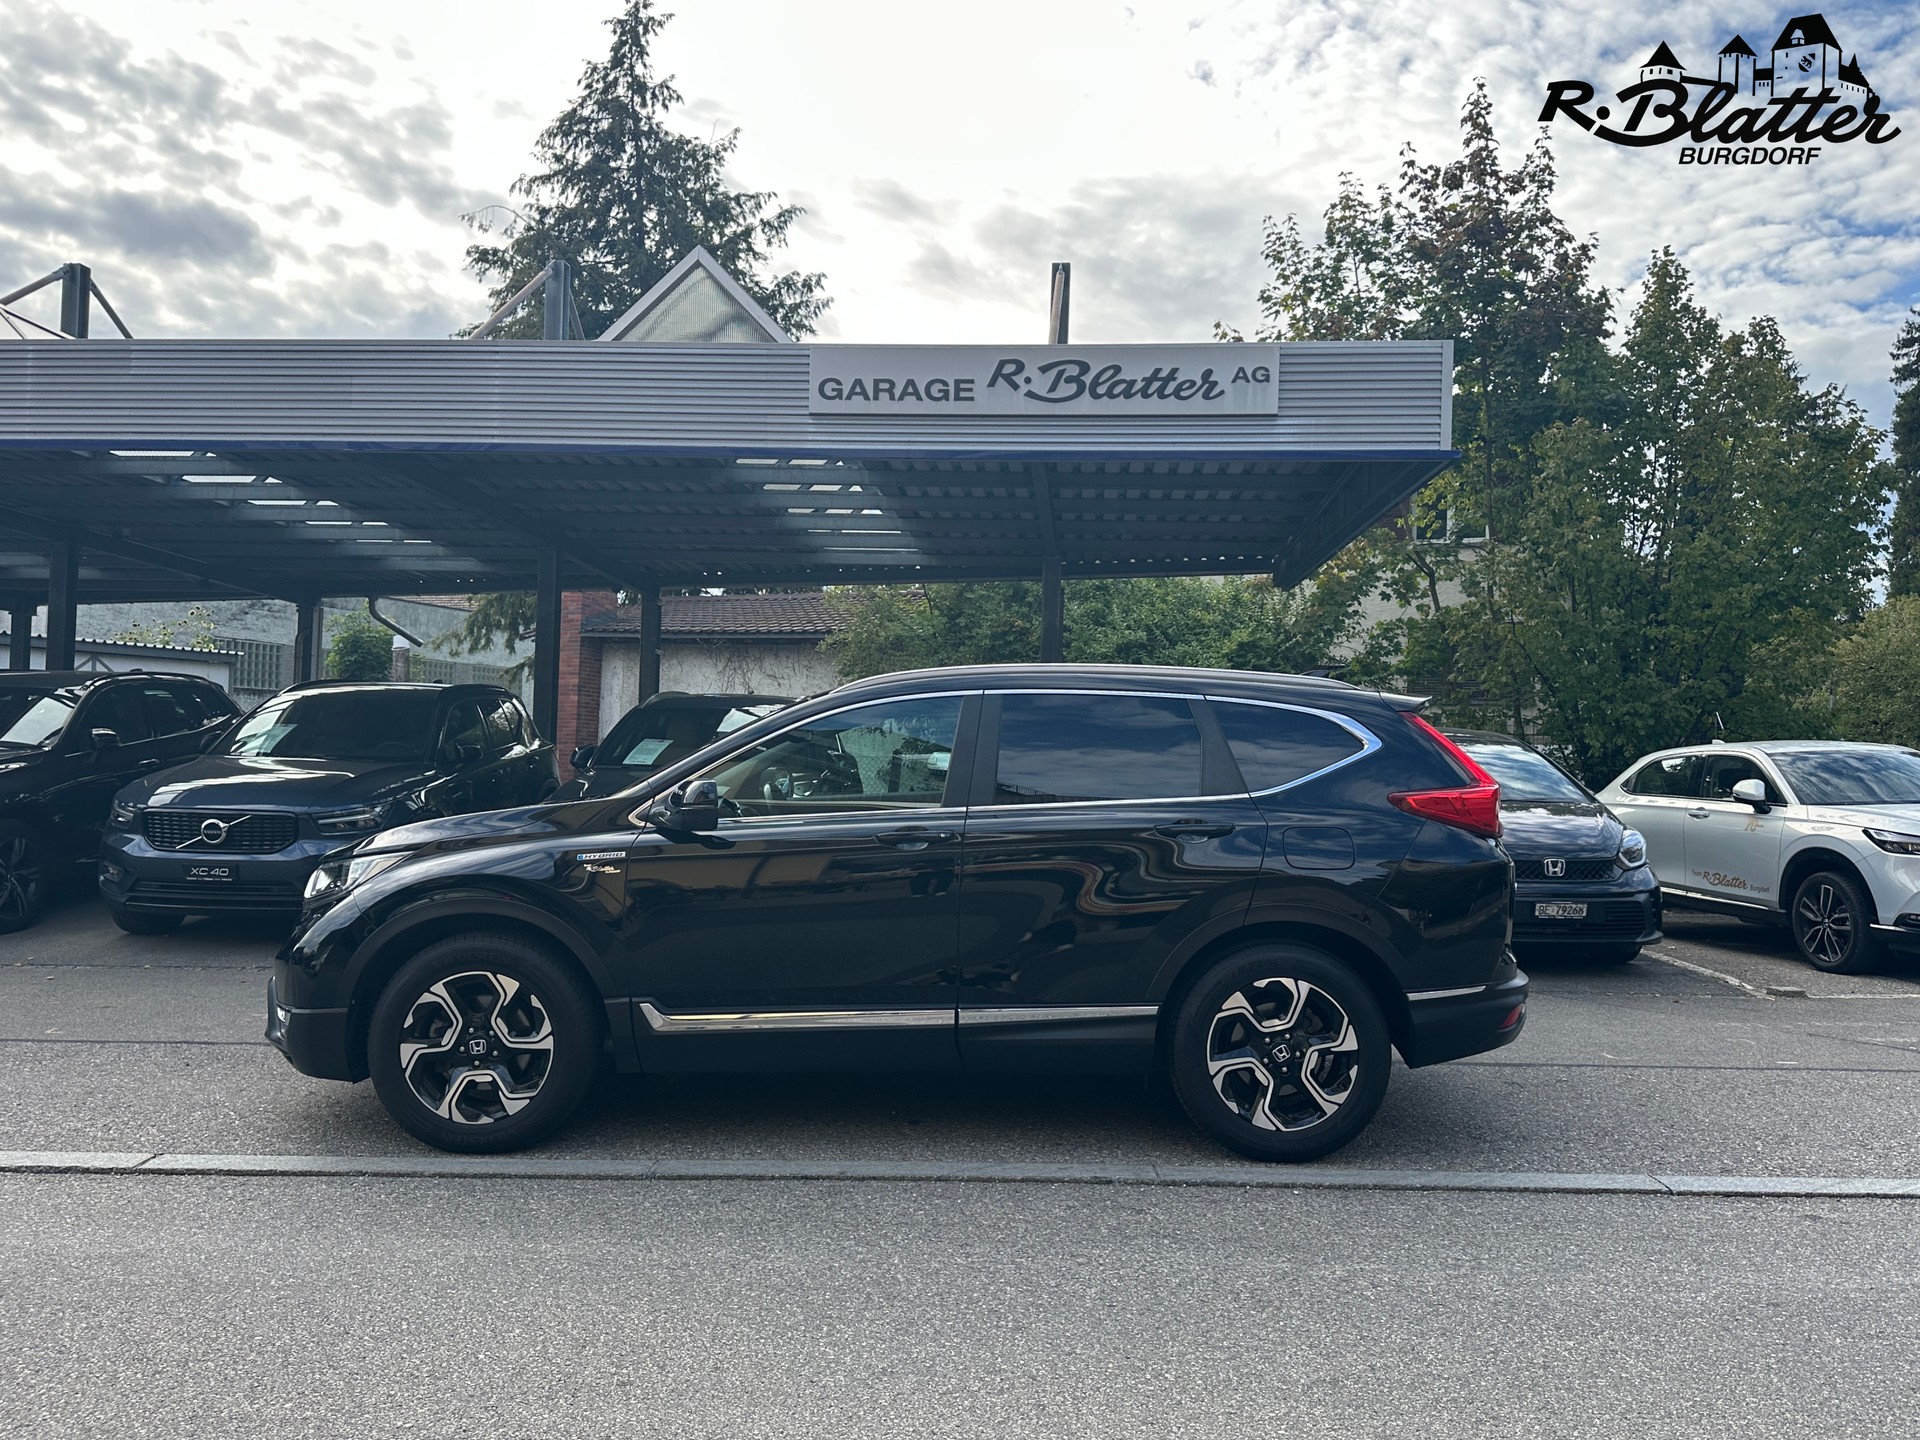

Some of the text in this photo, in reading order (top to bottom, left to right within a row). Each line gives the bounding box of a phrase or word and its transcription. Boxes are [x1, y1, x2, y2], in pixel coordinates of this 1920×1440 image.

[818, 378, 975, 402] GARAGE
[1231, 367, 1270, 383] AG
[190, 867, 229, 876] XC 40
